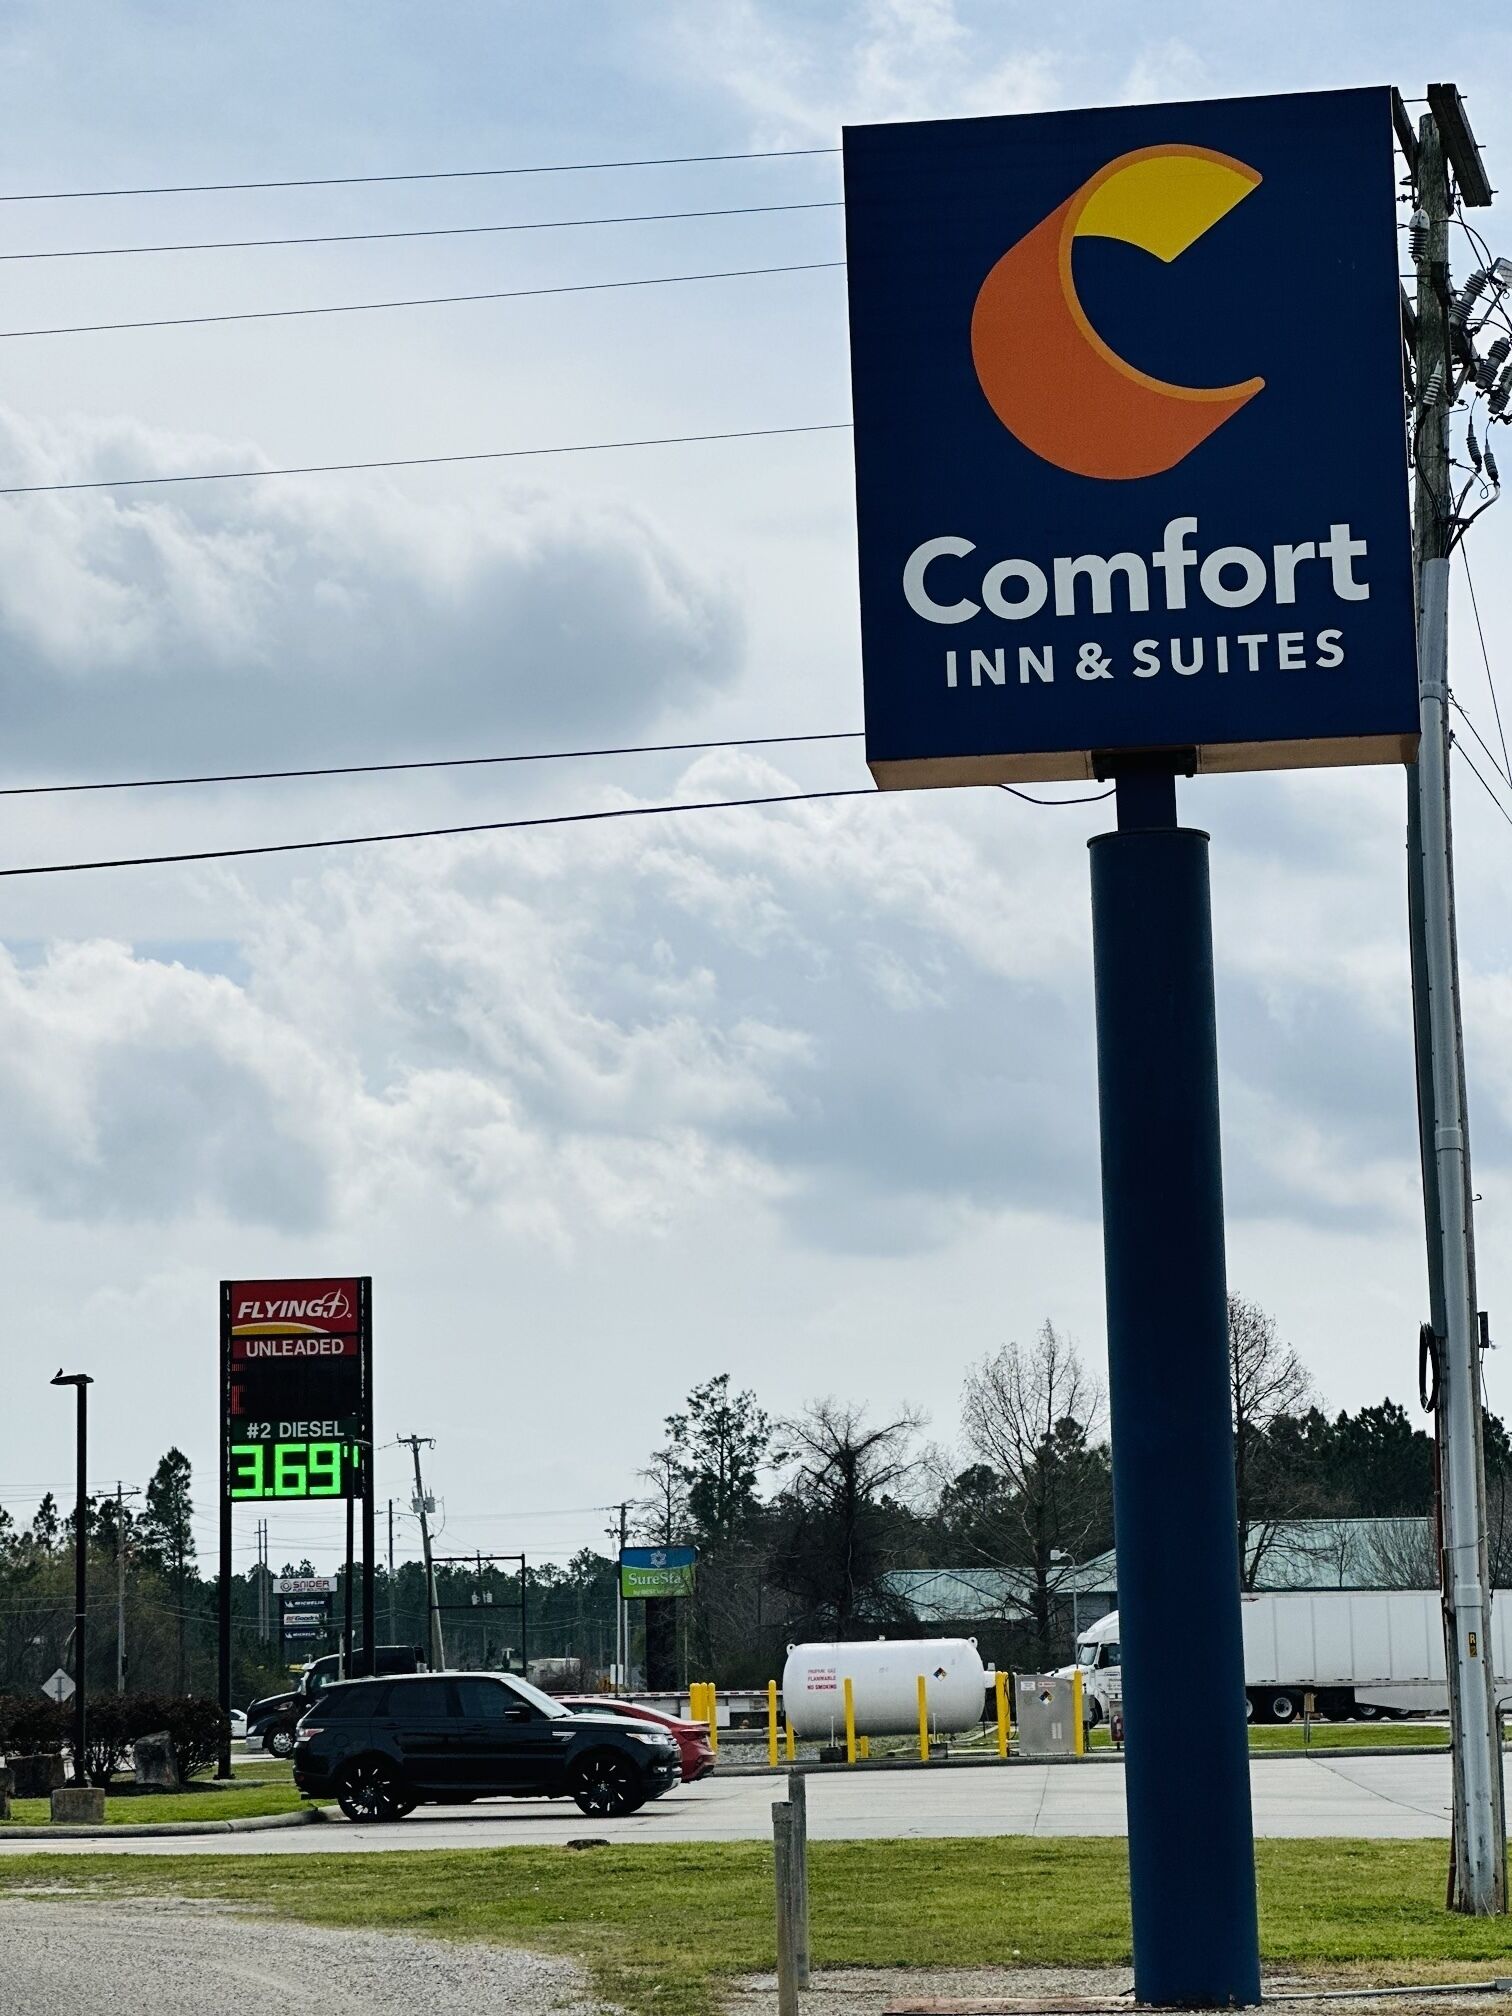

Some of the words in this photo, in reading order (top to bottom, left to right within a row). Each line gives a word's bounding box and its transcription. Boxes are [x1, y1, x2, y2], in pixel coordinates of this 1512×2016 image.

[903, 516, 1370, 624] Comfort
[945, 645, 1055, 688] INN
[1075, 641, 1114, 681] &
[1131, 628, 1345, 679] SUITES
[246, 1339, 344, 1357] UNLEADED
[247, 1422, 271, 1438] #2
[279, 1421, 344, 1438] DIESEL
[628, 1572, 688, 1588] SureStay
[1470, 1634, 1476, 1644] R
